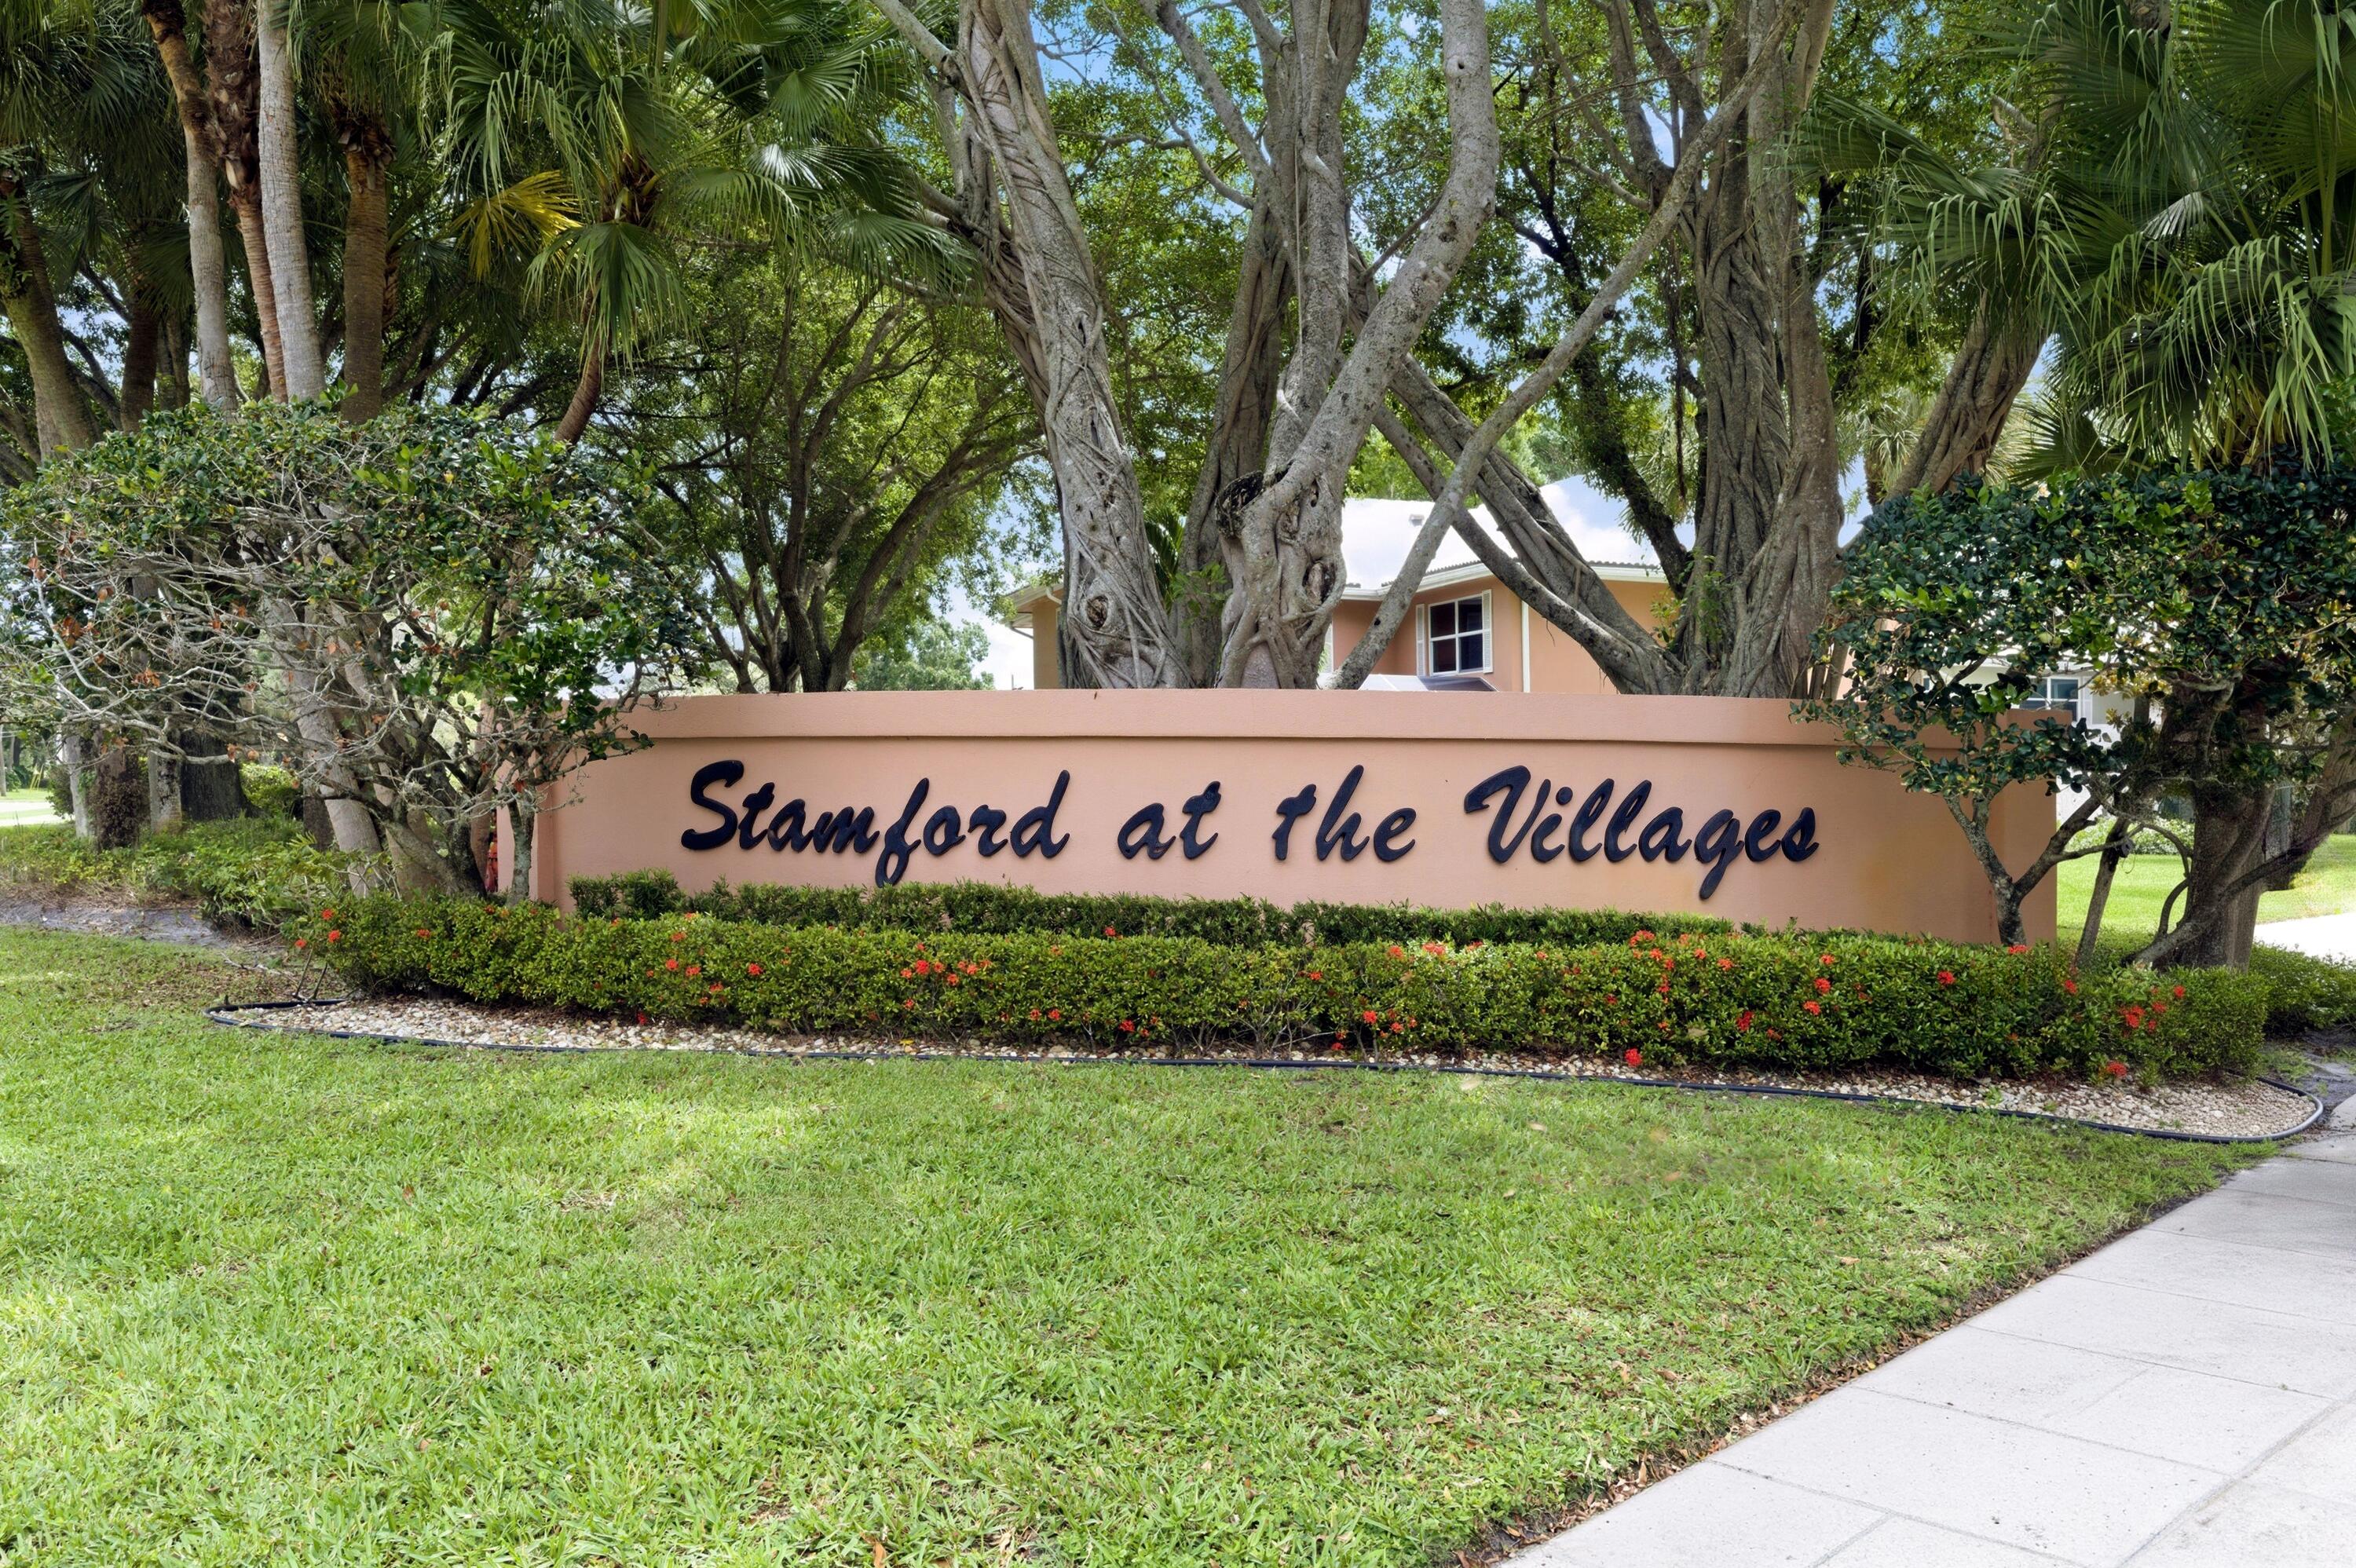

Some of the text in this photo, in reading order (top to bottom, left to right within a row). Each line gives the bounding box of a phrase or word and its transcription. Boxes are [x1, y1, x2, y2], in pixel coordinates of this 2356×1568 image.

[681, 760, 1820, 901] Stamford at the Villages
